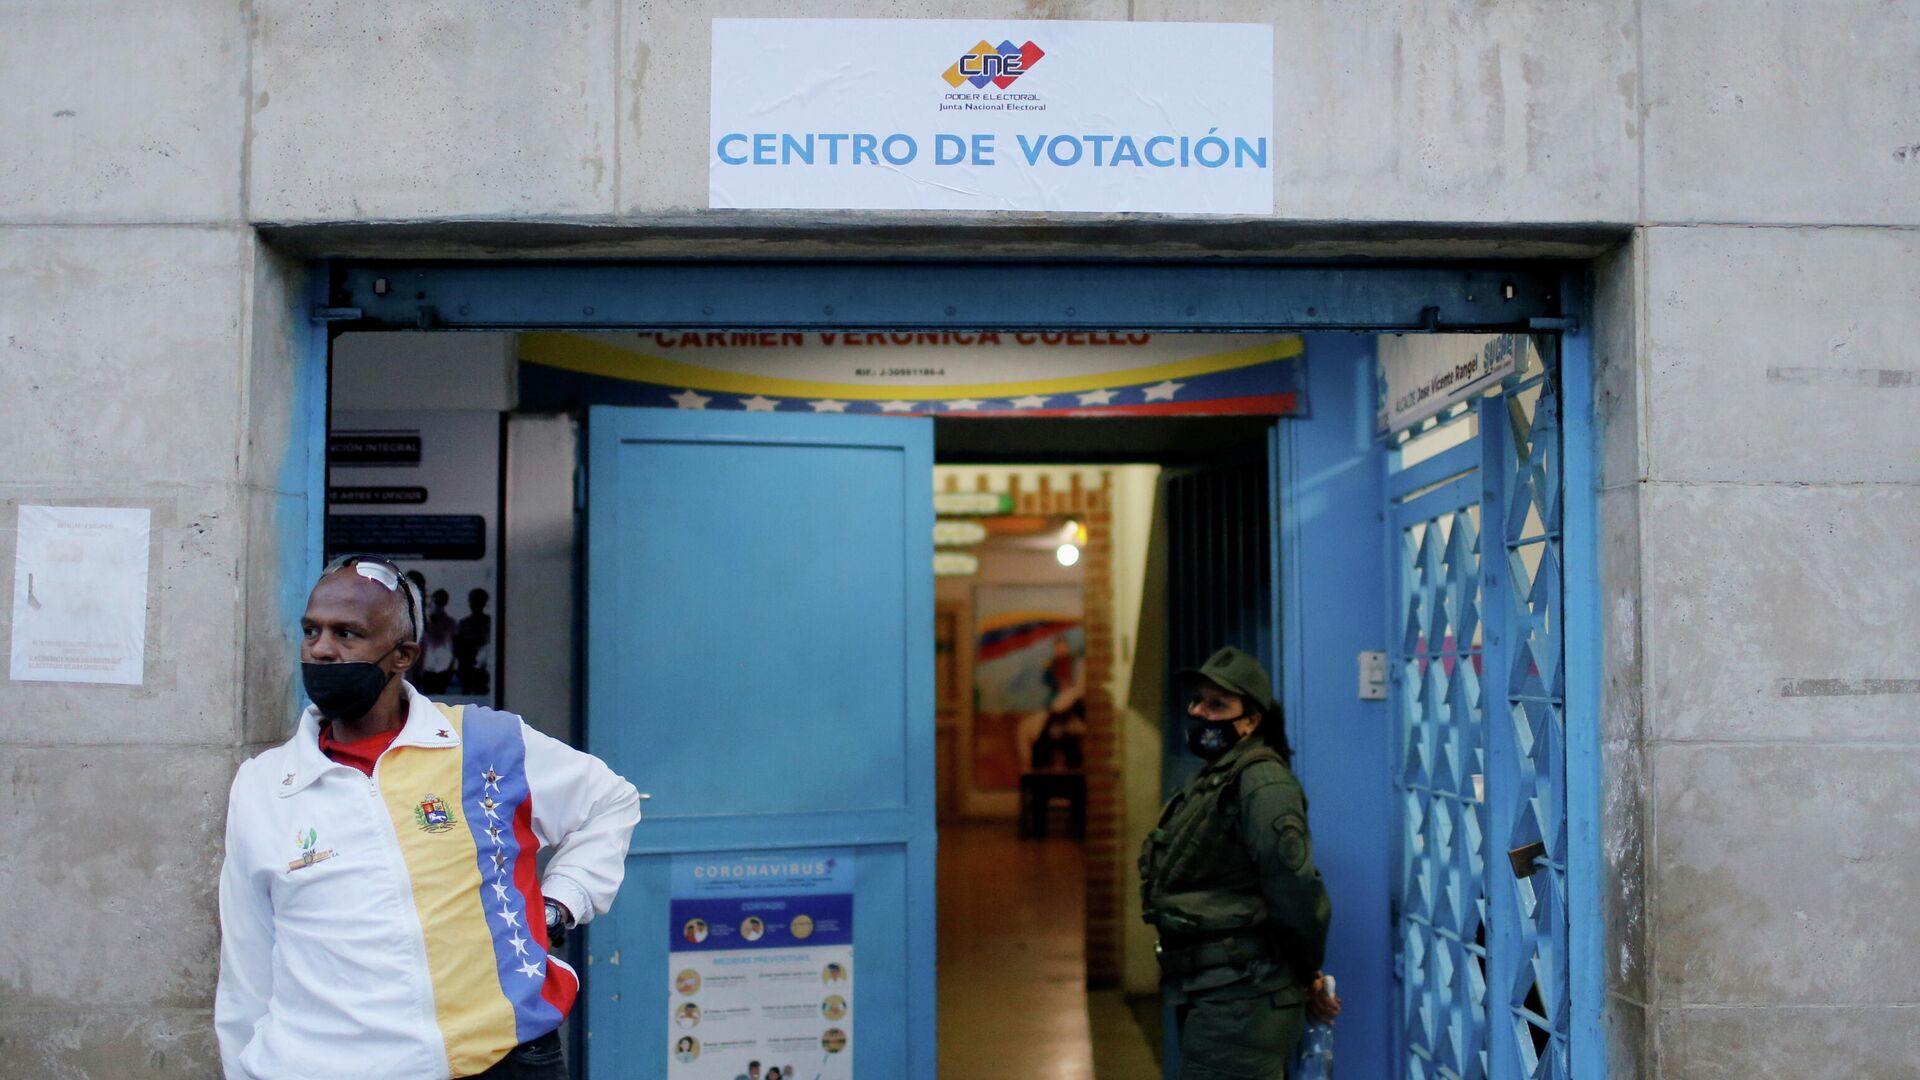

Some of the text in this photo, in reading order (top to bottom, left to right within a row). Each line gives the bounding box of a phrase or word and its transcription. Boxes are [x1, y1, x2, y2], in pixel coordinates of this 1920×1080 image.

[959, 54, 1025, 76] CNE
[944, 93, 1041, 101] PODER ELECTORAL
[938, 103, 1047, 112] Junta Nacional Electoral
[717, 127, 1267, 168] CENTRO DE VOTACIÓN
[1455, 353, 1479, 382] Rangel
[693, 862, 826, 879] CORONAVIRUS
